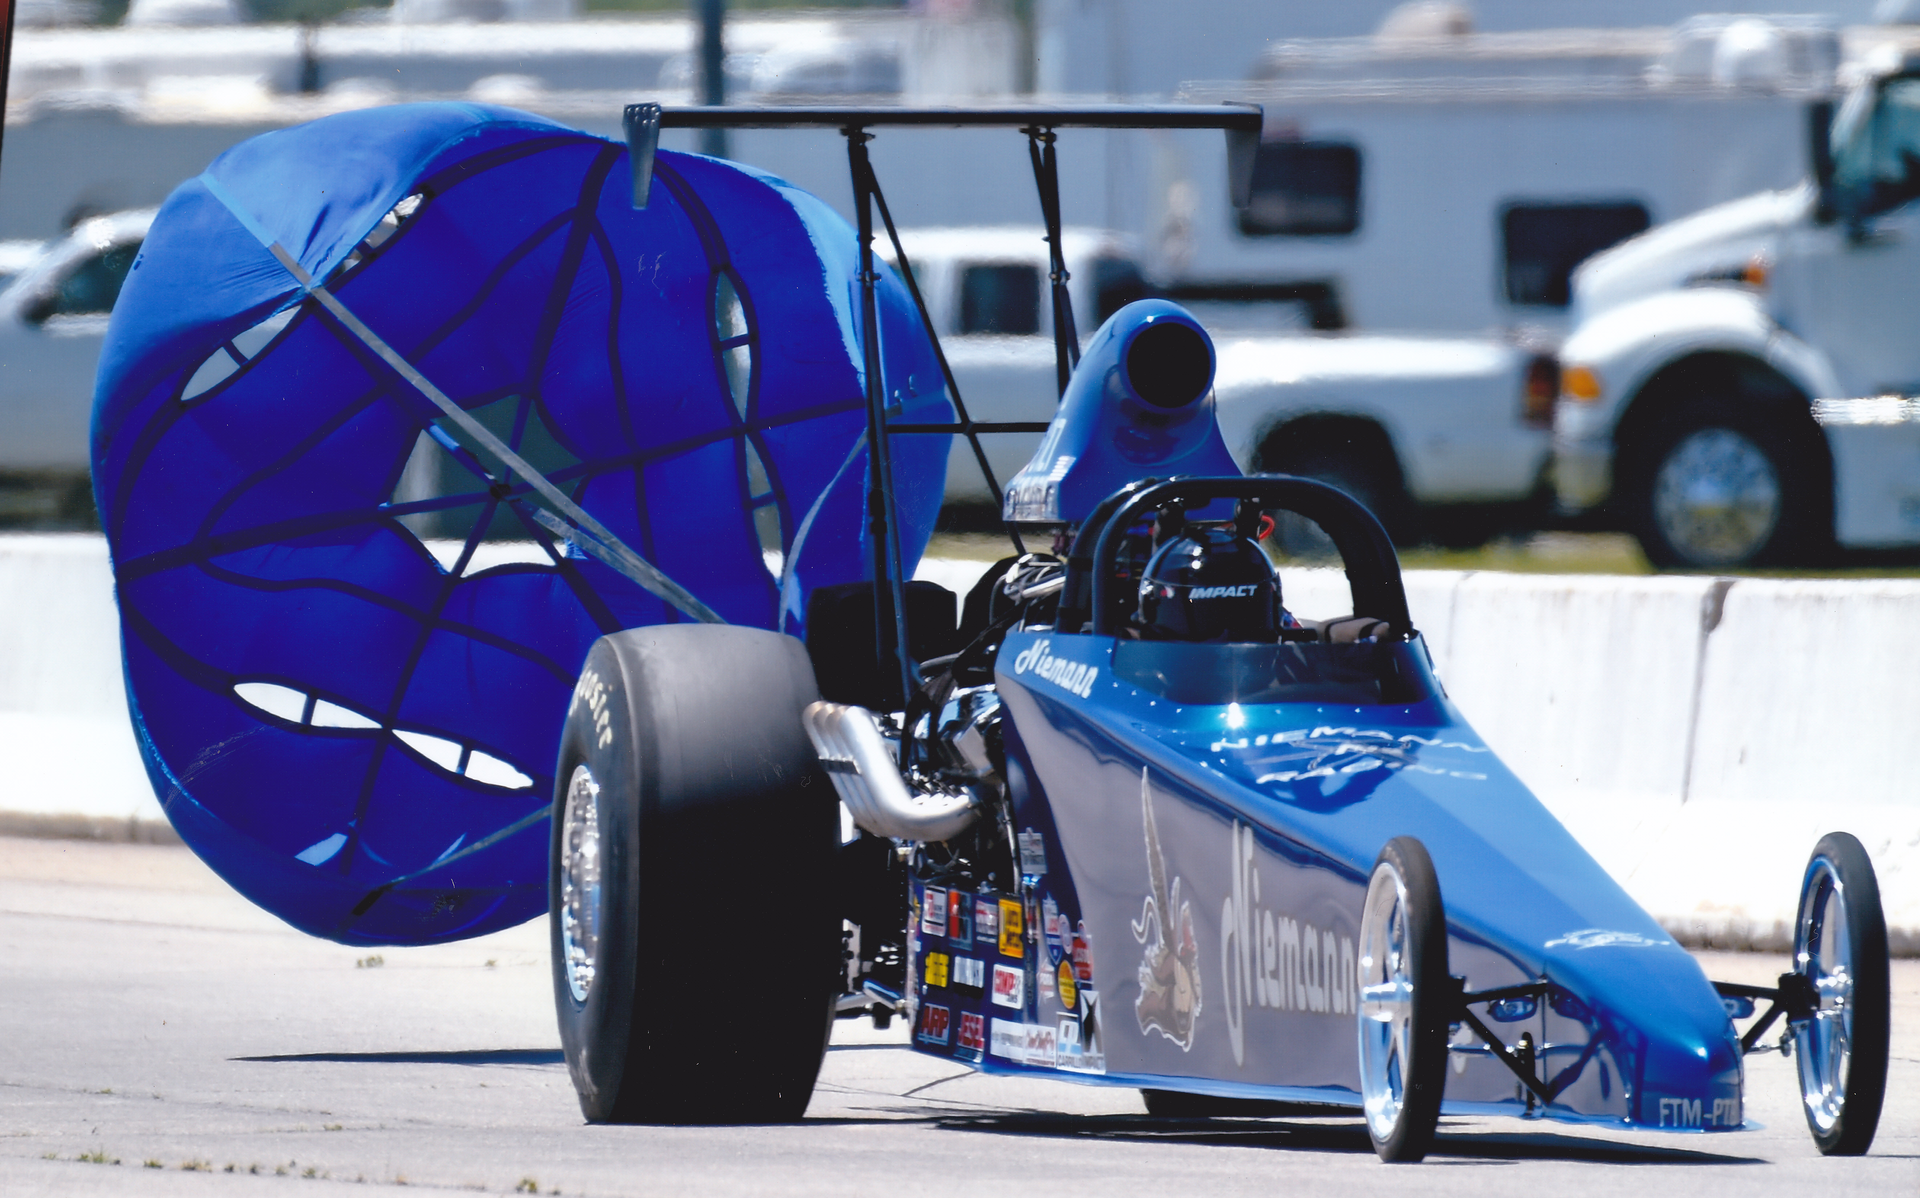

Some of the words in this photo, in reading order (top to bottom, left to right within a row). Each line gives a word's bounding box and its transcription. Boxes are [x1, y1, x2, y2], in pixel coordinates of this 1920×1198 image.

[1188, 584, 1258, 599] IMPACT
[1014, 638, 1099, 699] Niemann
[1221, 817, 1356, 1068] Niemann
[921, 1005, 949, 1039] ARP
